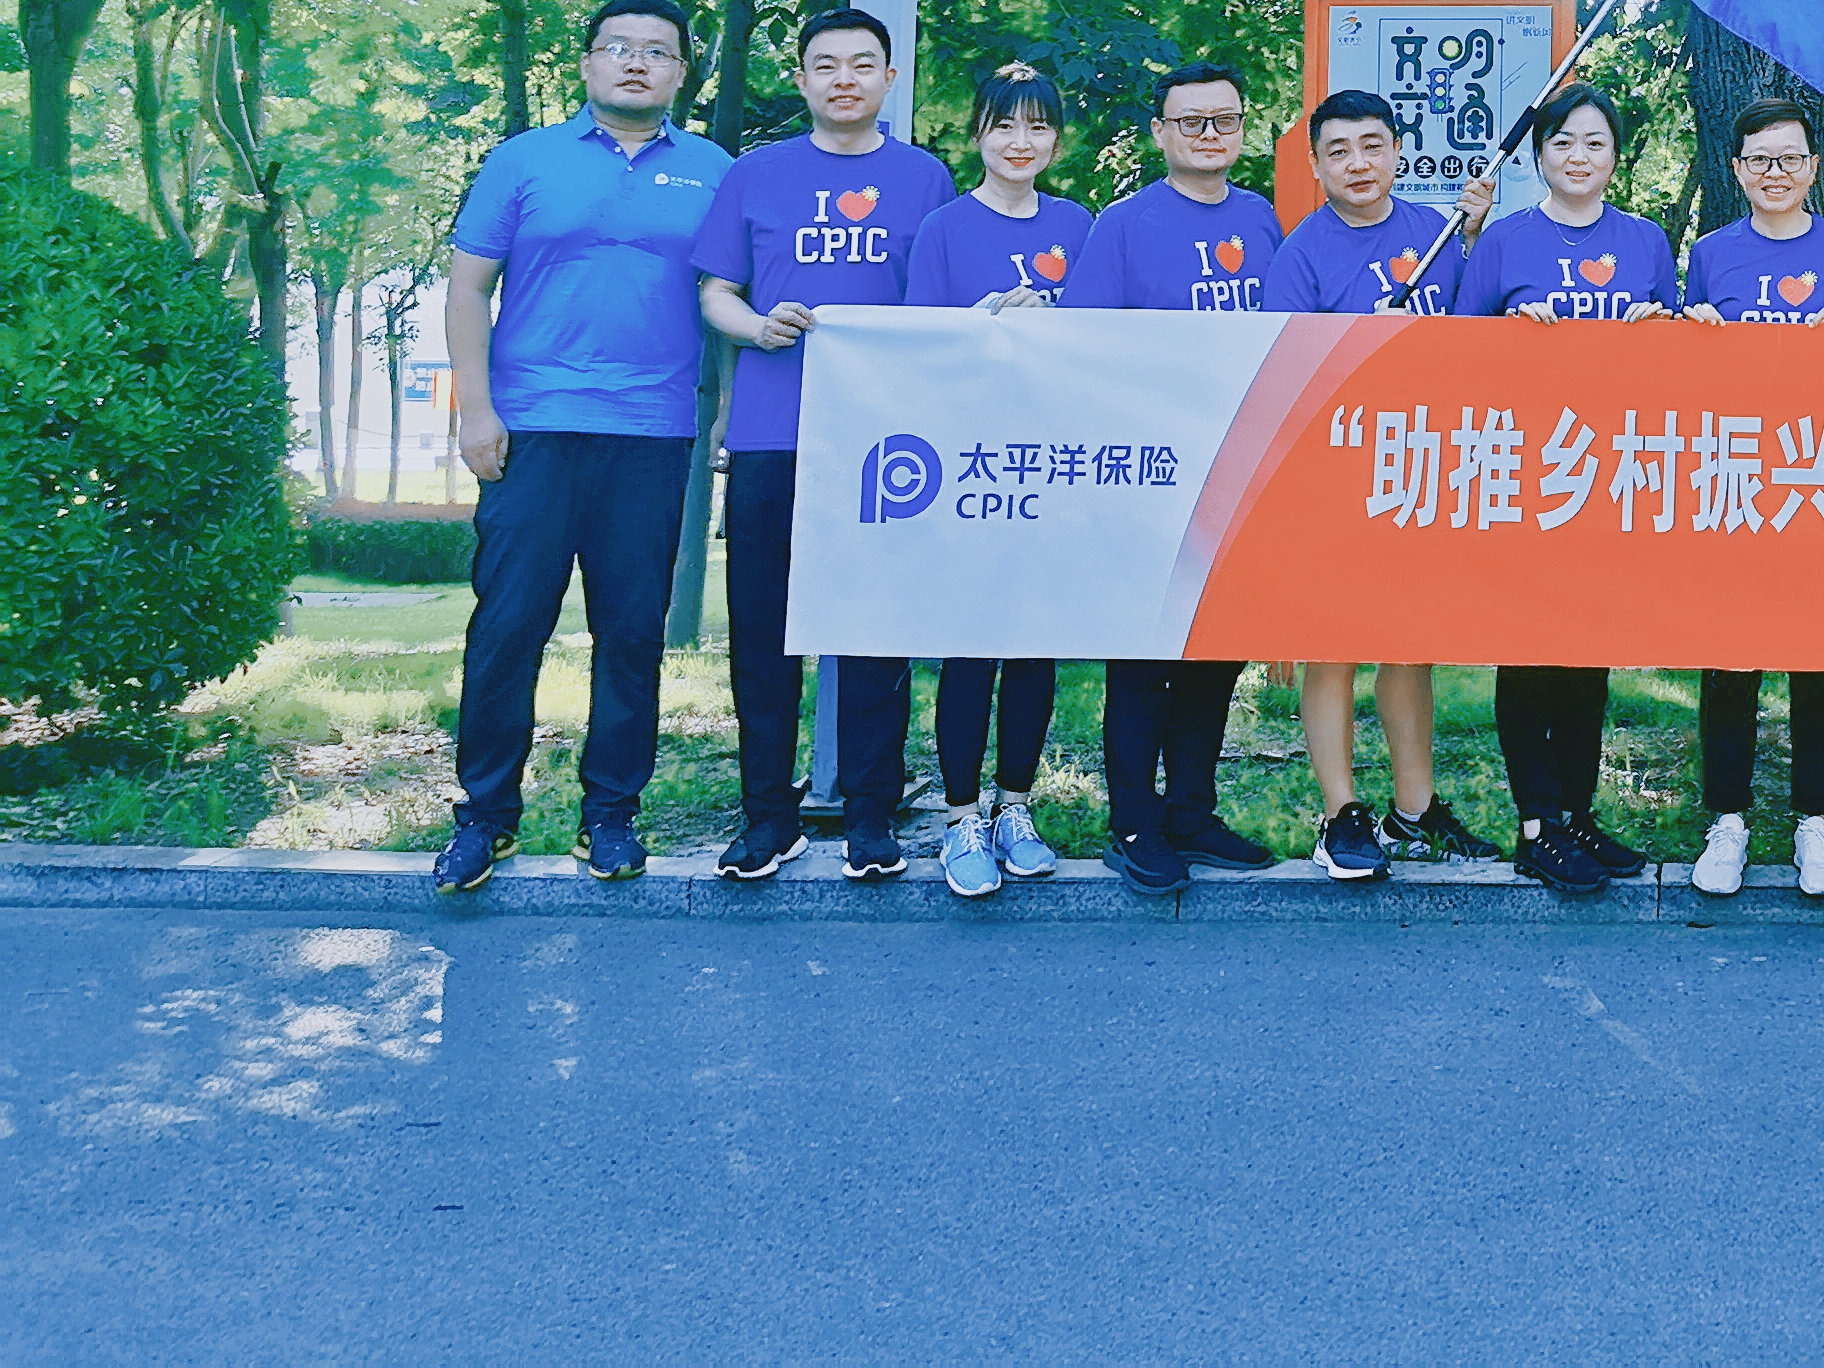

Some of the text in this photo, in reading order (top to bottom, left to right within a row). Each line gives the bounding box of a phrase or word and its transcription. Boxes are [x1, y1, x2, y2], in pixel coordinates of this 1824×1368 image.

[813, 190, 831, 223] I
[795, 226, 888, 263] CPIC
[1194, 241, 1213, 276] I
[1010, 253, 1033, 286] I
[1369, 261, 1393, 292] I
[1557, 258, 1576, 287] I
[1191, 278, 1260, 311] CPIC
[1756, 275, 1772, 306] I
[957, 442, 1178, 485] 太平洋保险
[956, 493, 1039, 519] CPIC
